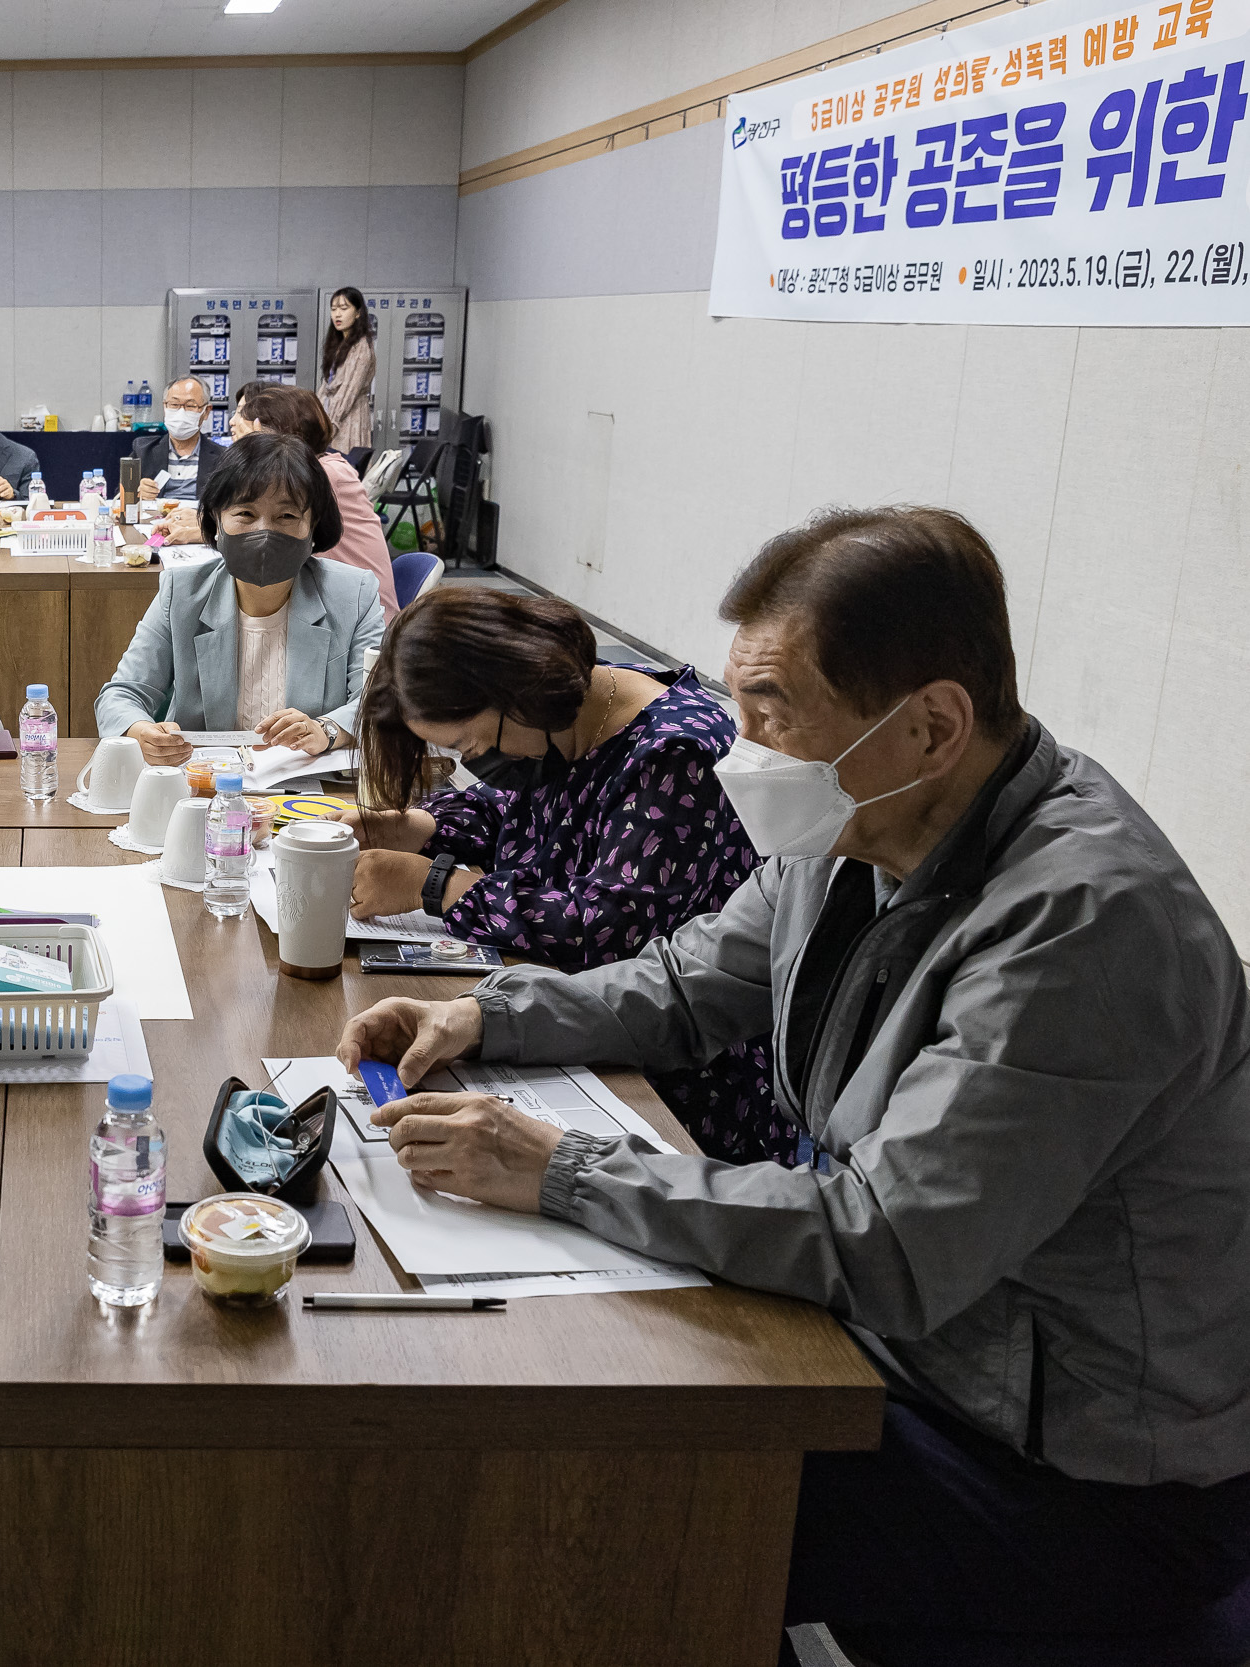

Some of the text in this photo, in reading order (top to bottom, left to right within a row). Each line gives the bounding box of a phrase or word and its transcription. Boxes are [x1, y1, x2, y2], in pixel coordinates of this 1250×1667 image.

[811, 95, 865, 131] 5급이상
[874, 73, 921, 116] 공무원
[1084, 15, 1139, 66] 예방
[1153, 0, 1214, 51] 교육
[747, 118, 781, 142] 광진구
[780, 60, 1248, 239] 평등한 공존을 위한
[778, 269, 799, 293] 대상
[808, 266, 850, 293] 광진구청
[854, 264, 899, 292] 5급이상
[903, 261, 943, 292] 공무원
[973, 259, 1003, 290] 일시
[1017, 248, 1155, 290] 2023.5.19.(금),
[1164, 241, 1248, 286] 22.(월),
